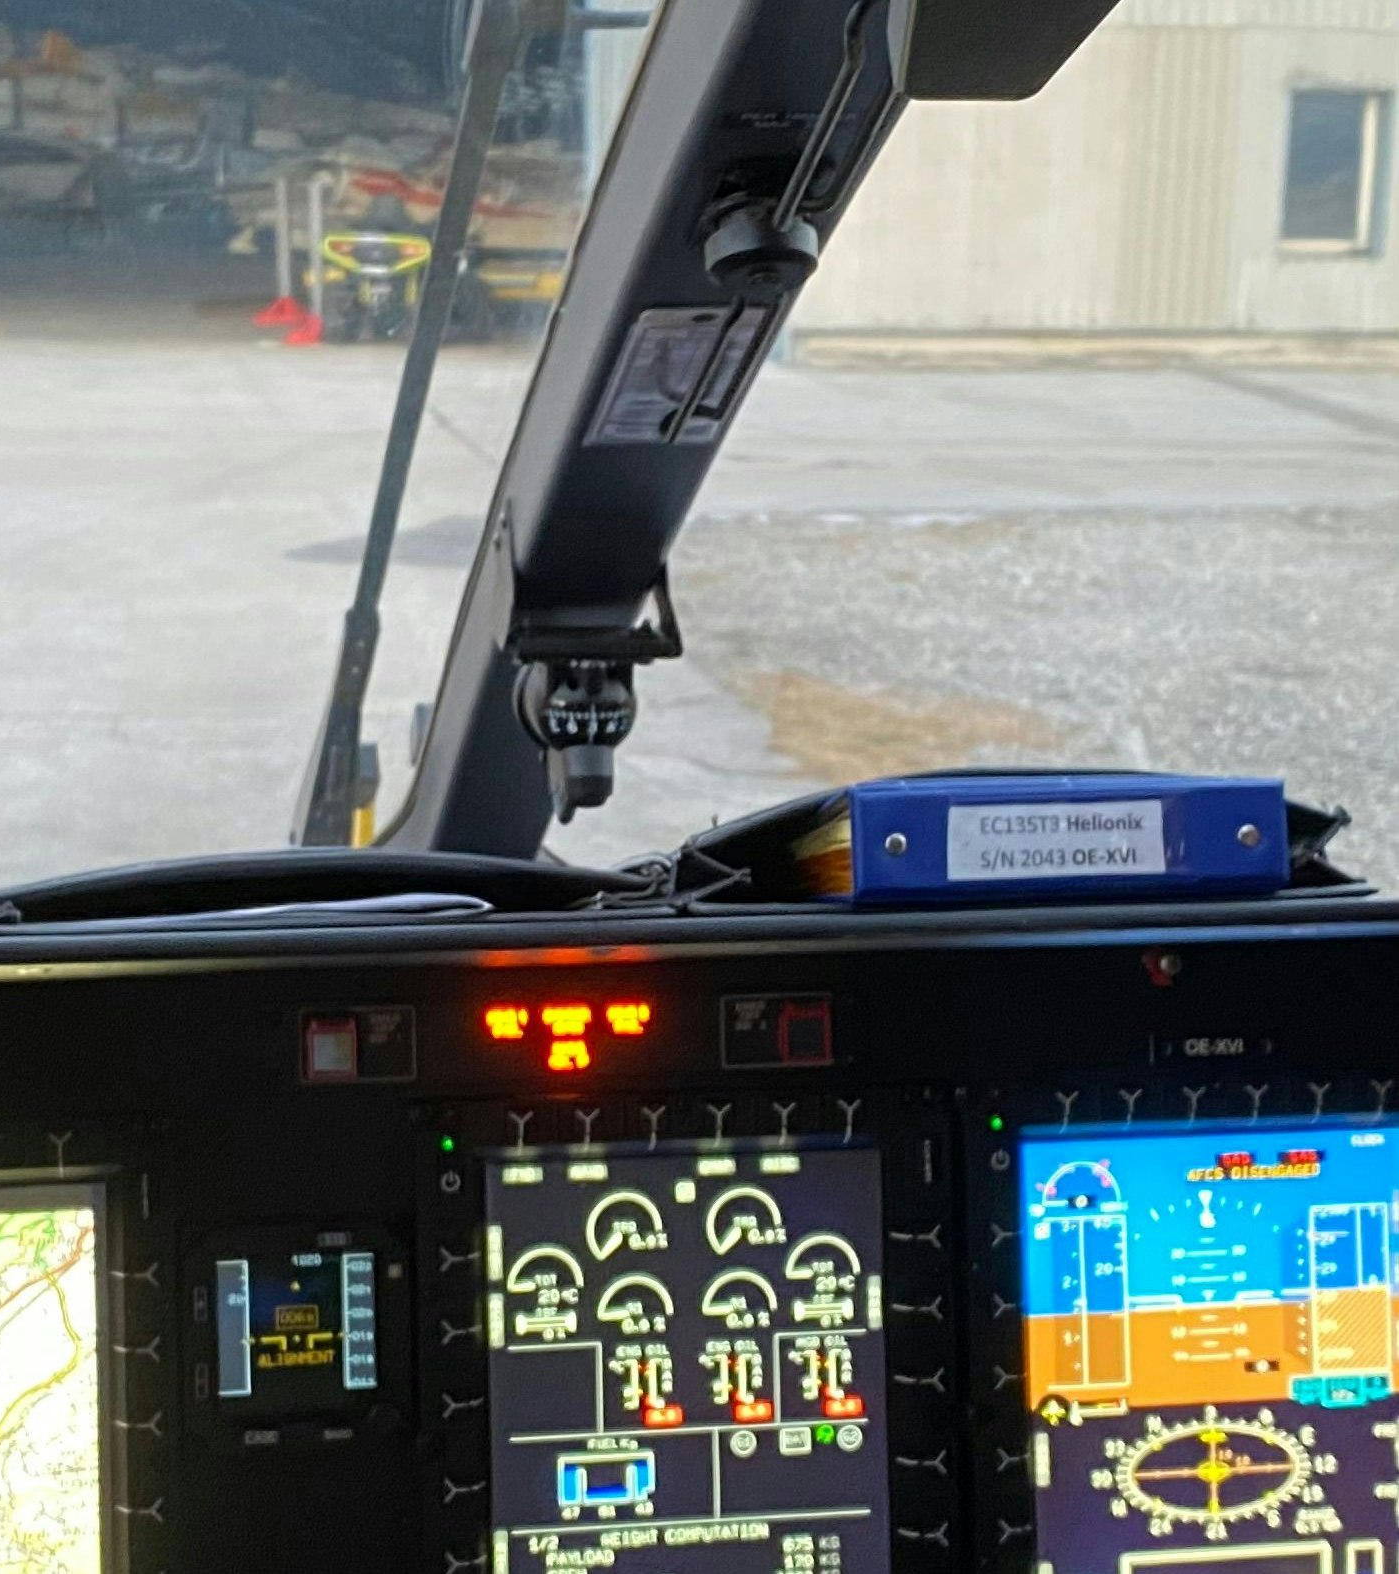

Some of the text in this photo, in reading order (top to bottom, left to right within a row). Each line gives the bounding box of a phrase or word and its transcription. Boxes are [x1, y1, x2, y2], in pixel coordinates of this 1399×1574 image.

[980, 811, 1143, 835] EC135T3 Helionix
[980, 846, 1137, 869] S/N 2043 OE-XVI
[1184, 1037, 1244, 1056] OE-XVI
[1187, 1162, 1321, 1181] AFCS DISENGAGED
[257, 1349, 336, 1368] ALIGNMENT
[600, 1522, 770, 1551] WEIGHT COMPUTATION
[545, 1549, 615, 1567] PAYLOAD
